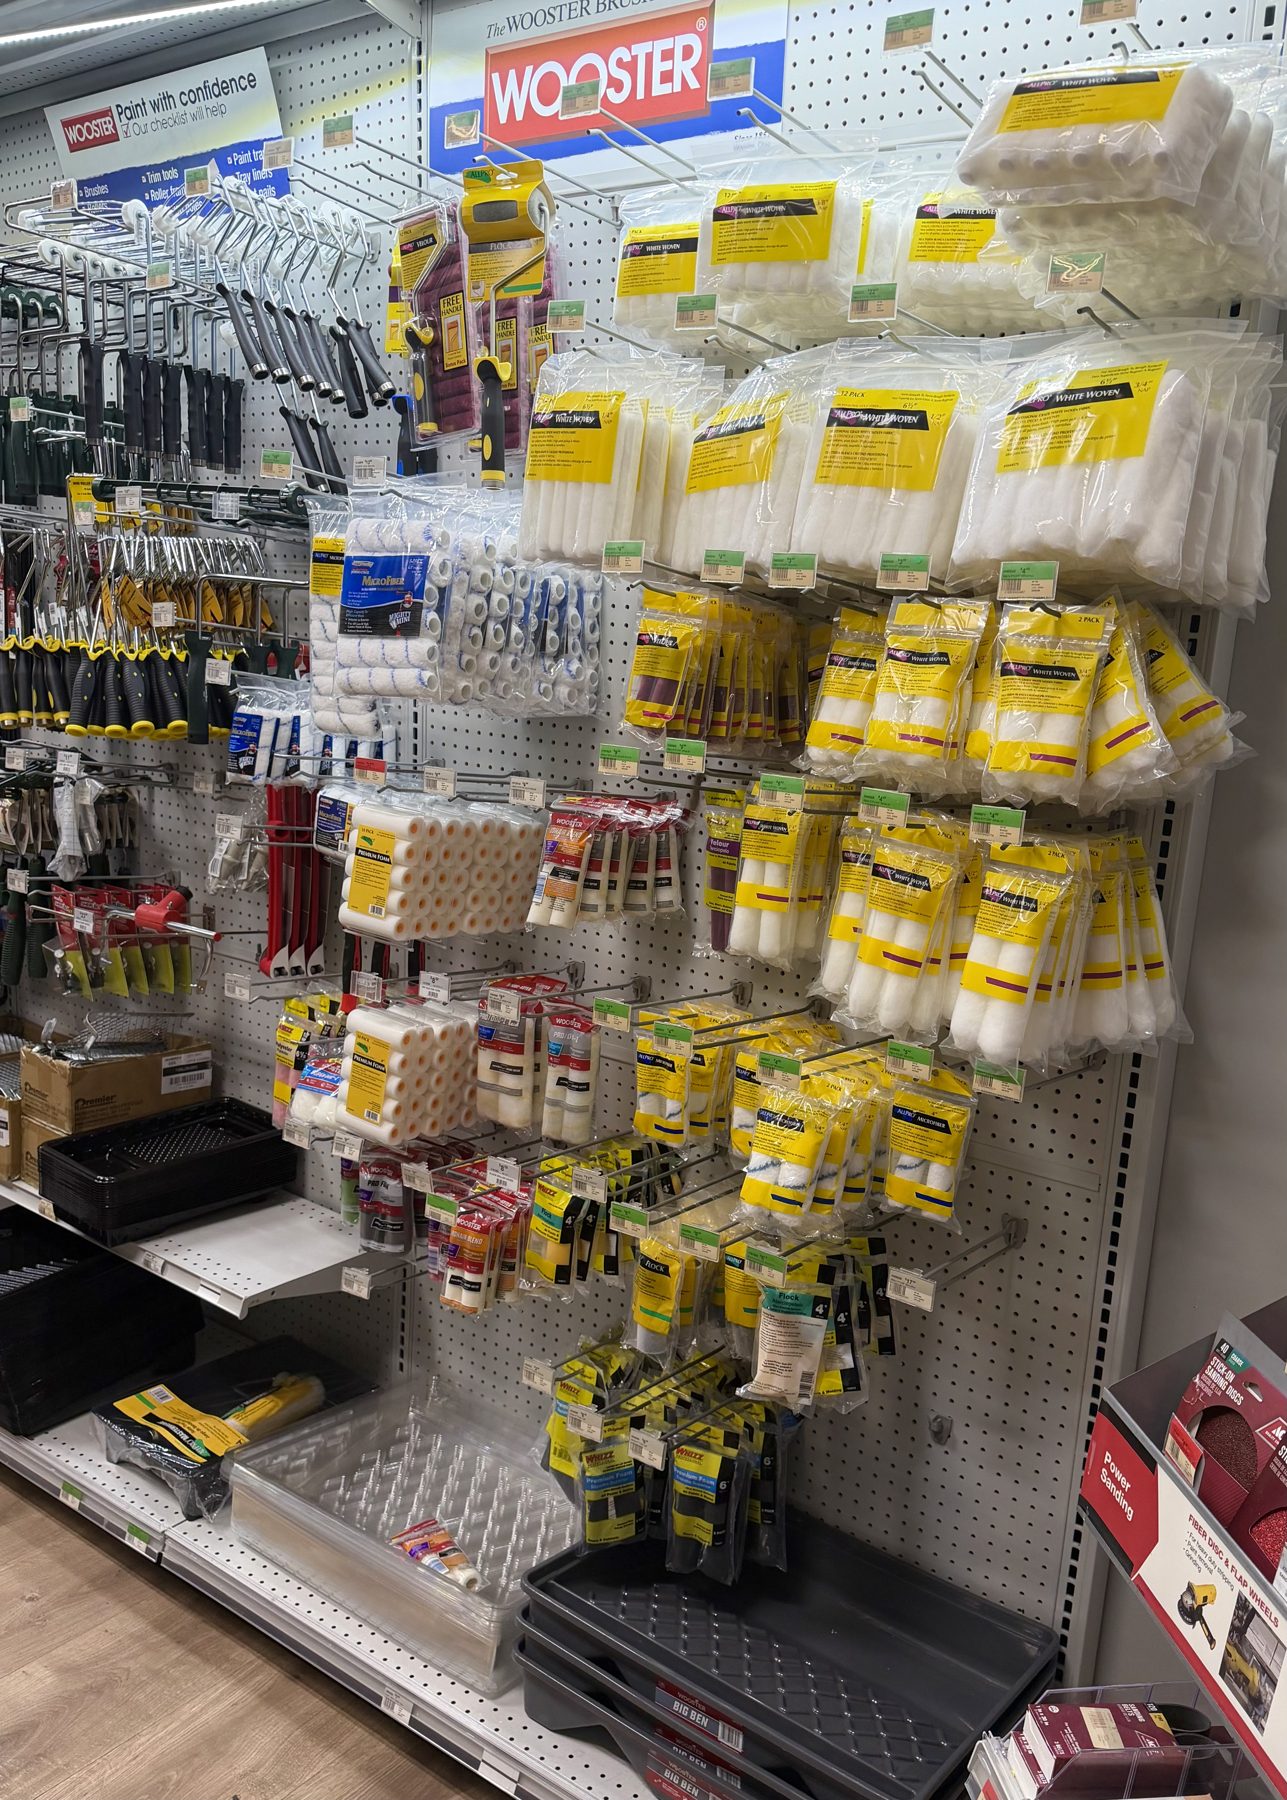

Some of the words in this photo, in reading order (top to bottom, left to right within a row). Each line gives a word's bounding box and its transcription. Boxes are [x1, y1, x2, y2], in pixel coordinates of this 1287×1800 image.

[486, 23, 506, 39] The
[506, 0, 590, 31] WOOSTER
[1060, 78, 1087, 87] WHITE
[115, 99, 148, 123] Paint
[149, 90, 177, 113] with
[178, 71, 257, 107] confidence
[132, 121, 149, 137] Our
[150, 111, 189, 132] checklist
[190, 107, 205, 122] will
[206, 101, 228, 120] help
[64, 118, 116, 145] WOOSTER
[233, 152, 254, 166] Paint
[146, 170, 162, 184] Trim
[163, 167, 179, 181] tools
[84, 183, 109, 198] Brushes
[150, 188, 170, 202] Roller
[416, 237, 434, 249] VELOUR
[645, 243, 662, 251] WHITE
[662, 242, 680, 250] WOVEN
[442, 294, 460, 309] FREE
[441, 304, 463, 318] HANDLE
[497, 319, 514, 332] FREE
[496, 329, 516, 338] HANDLE
[528, 333, 551, 345] HANDLE
[848, 390, 865, 398] PACK
[1055, 393, 1084, 403] WHITE
[1086, 388, 1121, 399] WOVEN
[361, 575, 405, 586] MICROFIBER
[1078, 616, 1083, 624] 2
[1083, 616, 1100, 624] PACK
[1032, 667, 1052, 675] WHITE
[1053, 669, 1077, 678] WOVEN
[357, 849, 377, 860] PREMIUM
[377, 854, 390, 864] FOAM
[555, 1017, 581, 1030] WOOSTER
[353, 1055, 372, 1068] PREMIUM
[372, 1062, 386, 1073] FOAM
[831, 1084, 843, 1094] PACK
[74, 1093, 117, 1110] Premier
[896, 1107, 917, 1119] ALLPRO
[916, 1115, 947, 1130] MICROFIBER
[538, 1182, 558, 1198] WHIZZ
[645, 1260, 665, 1273] FLOCK
[778, 1291, 800, 1303] Flock
[815, 1303, 828, 1315] 4"
[836, 1311, 849, 1324] 4"
[1220, 1342, 1229, 1355] 40
[1230, 1352, 1244, 1368] COARSE
[1210, 1356, 1236, 1384] STICK-ON
[558, 1380, 580, 1397] WHIZZ
[1204, 1364, 1228, 1392] SANDING
[1226, 1385, 1244, 1407] DISCS
[585, 1451, 615, 1464] WHIZZ
[675, 1446, 705, 1463] WHIZZ
[586, 1475, 615, 1487] Premium
[615, 1470, 634, 1482] Foam
[1104, 1450, 1132, 1493] Power
[719, 1480, 730, 1493] 6"
[1099, 1467, 1135, 1525] Sanding
[1185, 1548, 1204, 1577] Grinding
[1186, 1540, 1198, 1558] Paint
[1196, 1552, 1215, 1579] removal
[1188, 1532, 1196, 1543] For
[1194, 1539, 1209, 1563] heavy
[1207, 1552, 1219, 1571] duty
[1217, 1563, 1236, 1593] stripping
[1188, 1514, 1209, 1545] FIBER
[1207, 1538, 1225, 1564] DISC
[1224, 1558, 1231, 1571] &
[1230, 1564, 1249, 1593] FLAP
[1248, 1585, 1281, 1631] WHEELS
[677, 1691, 706, 1713] WOOSTER
[672, 1700, 688, 1717] BIG
[689, 1709, 709, 1731] BEN
[1121, 1703, 1136, 1718] BELTS
[1128, 1703, 1146, 1724] SANDING
[668, 1760, 697, 1784] WOOSTER
[663, 1768, 680, 1786] BIG
[680, 1777, 699, 1799] BEN
